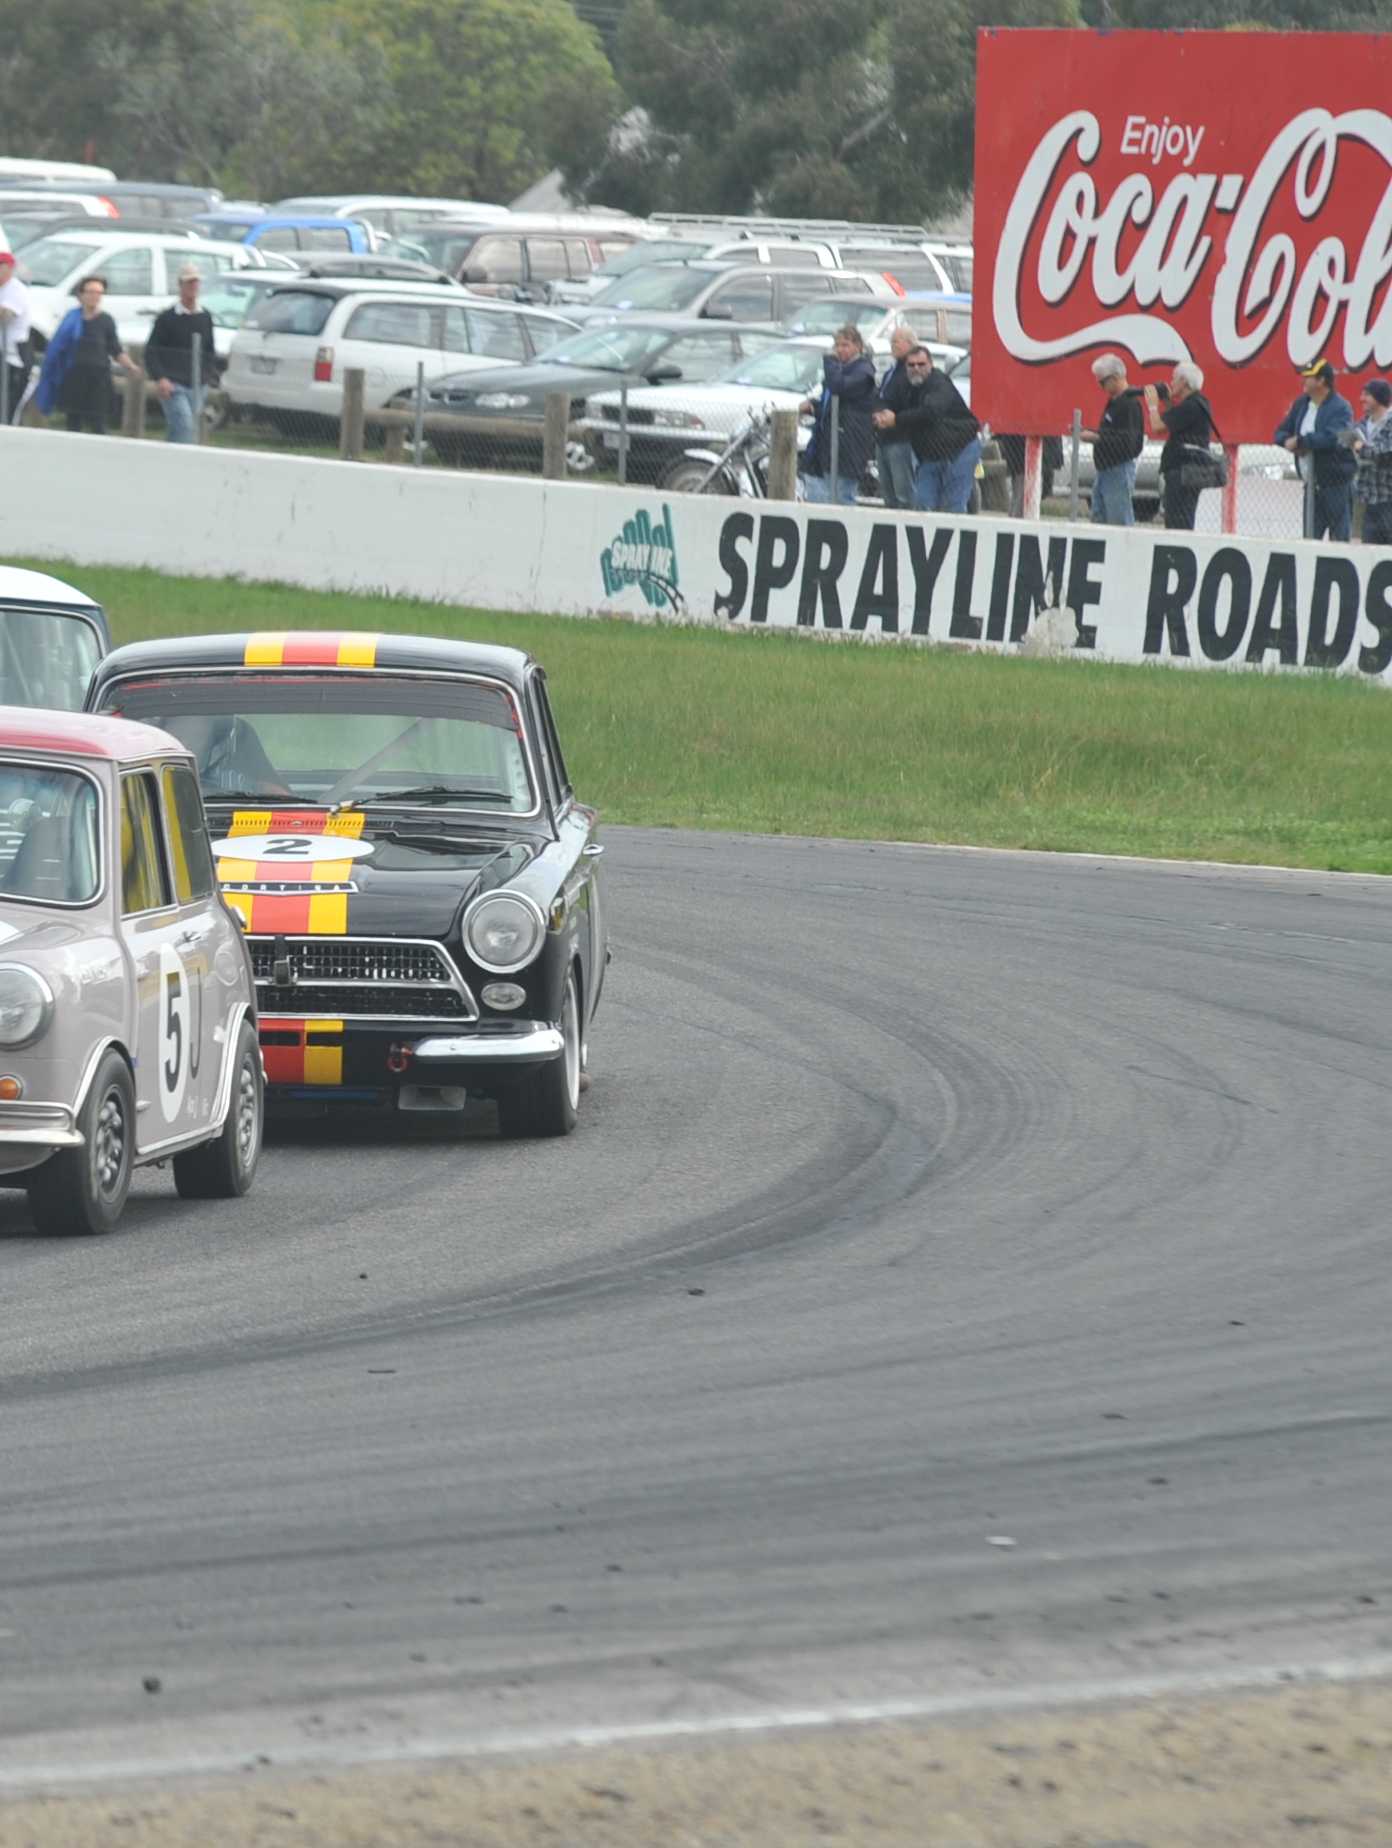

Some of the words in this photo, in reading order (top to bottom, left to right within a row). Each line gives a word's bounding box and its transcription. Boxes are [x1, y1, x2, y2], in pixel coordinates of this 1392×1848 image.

[1120, 115, 1205, 166] Enjoy
[714, 511, 1107, 650] SPRAYLINE
[1143, 544, 1392, 675] ROADS
[262, 838, 313, 855] 2
[222, 883, 340, 892] CORTINA
[164, 970, 182, 1093] 5
